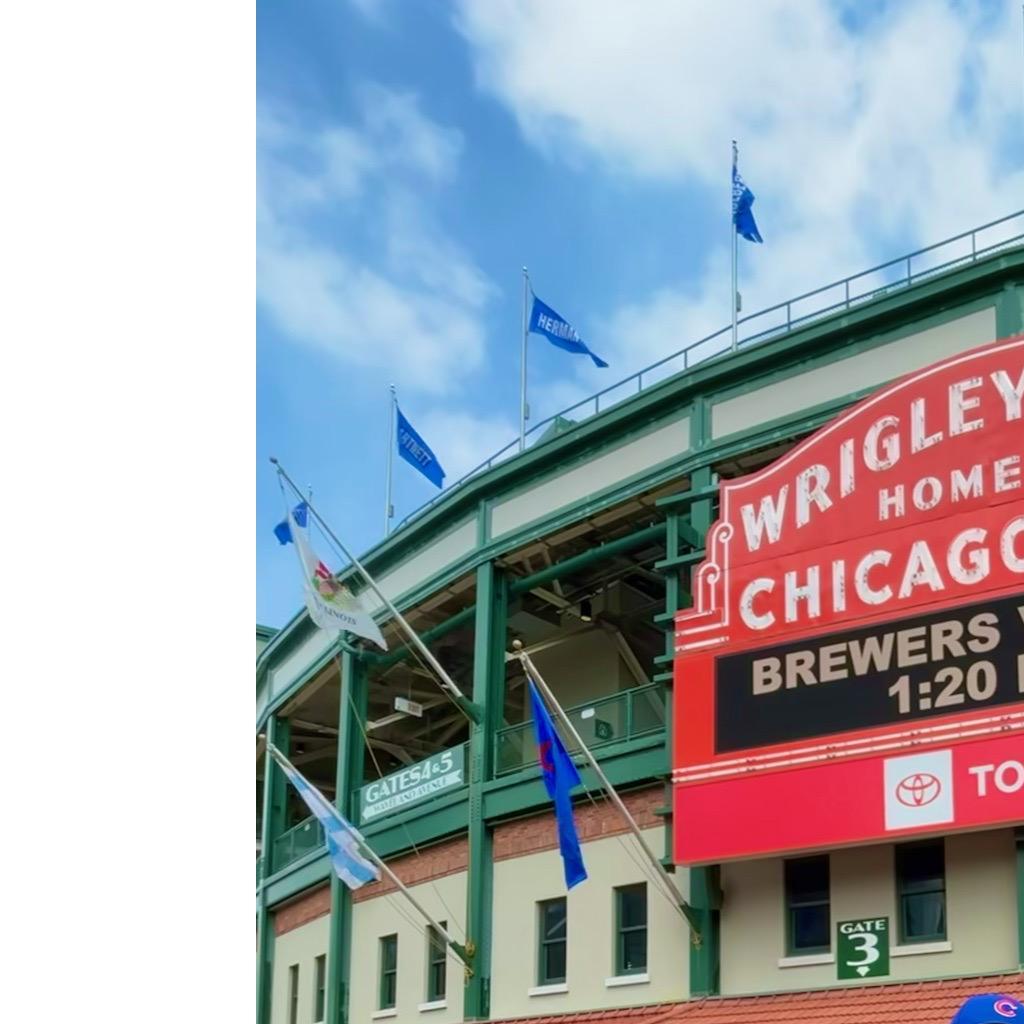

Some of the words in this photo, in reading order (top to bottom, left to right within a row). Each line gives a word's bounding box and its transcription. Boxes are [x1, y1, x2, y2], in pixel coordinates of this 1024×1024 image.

[878, 455, 1022, 521] HOME
[752, 612, 1001, 696] BREWERS
[888, 660, 998, 714] 1:20
[366, 765, 421, 803] GATES
[420, 761, 432, 779] 4
[440, 751, 454, 774] 5
[840, 919, 886, 934] GATE
[846, 932, 880, 966] 3
